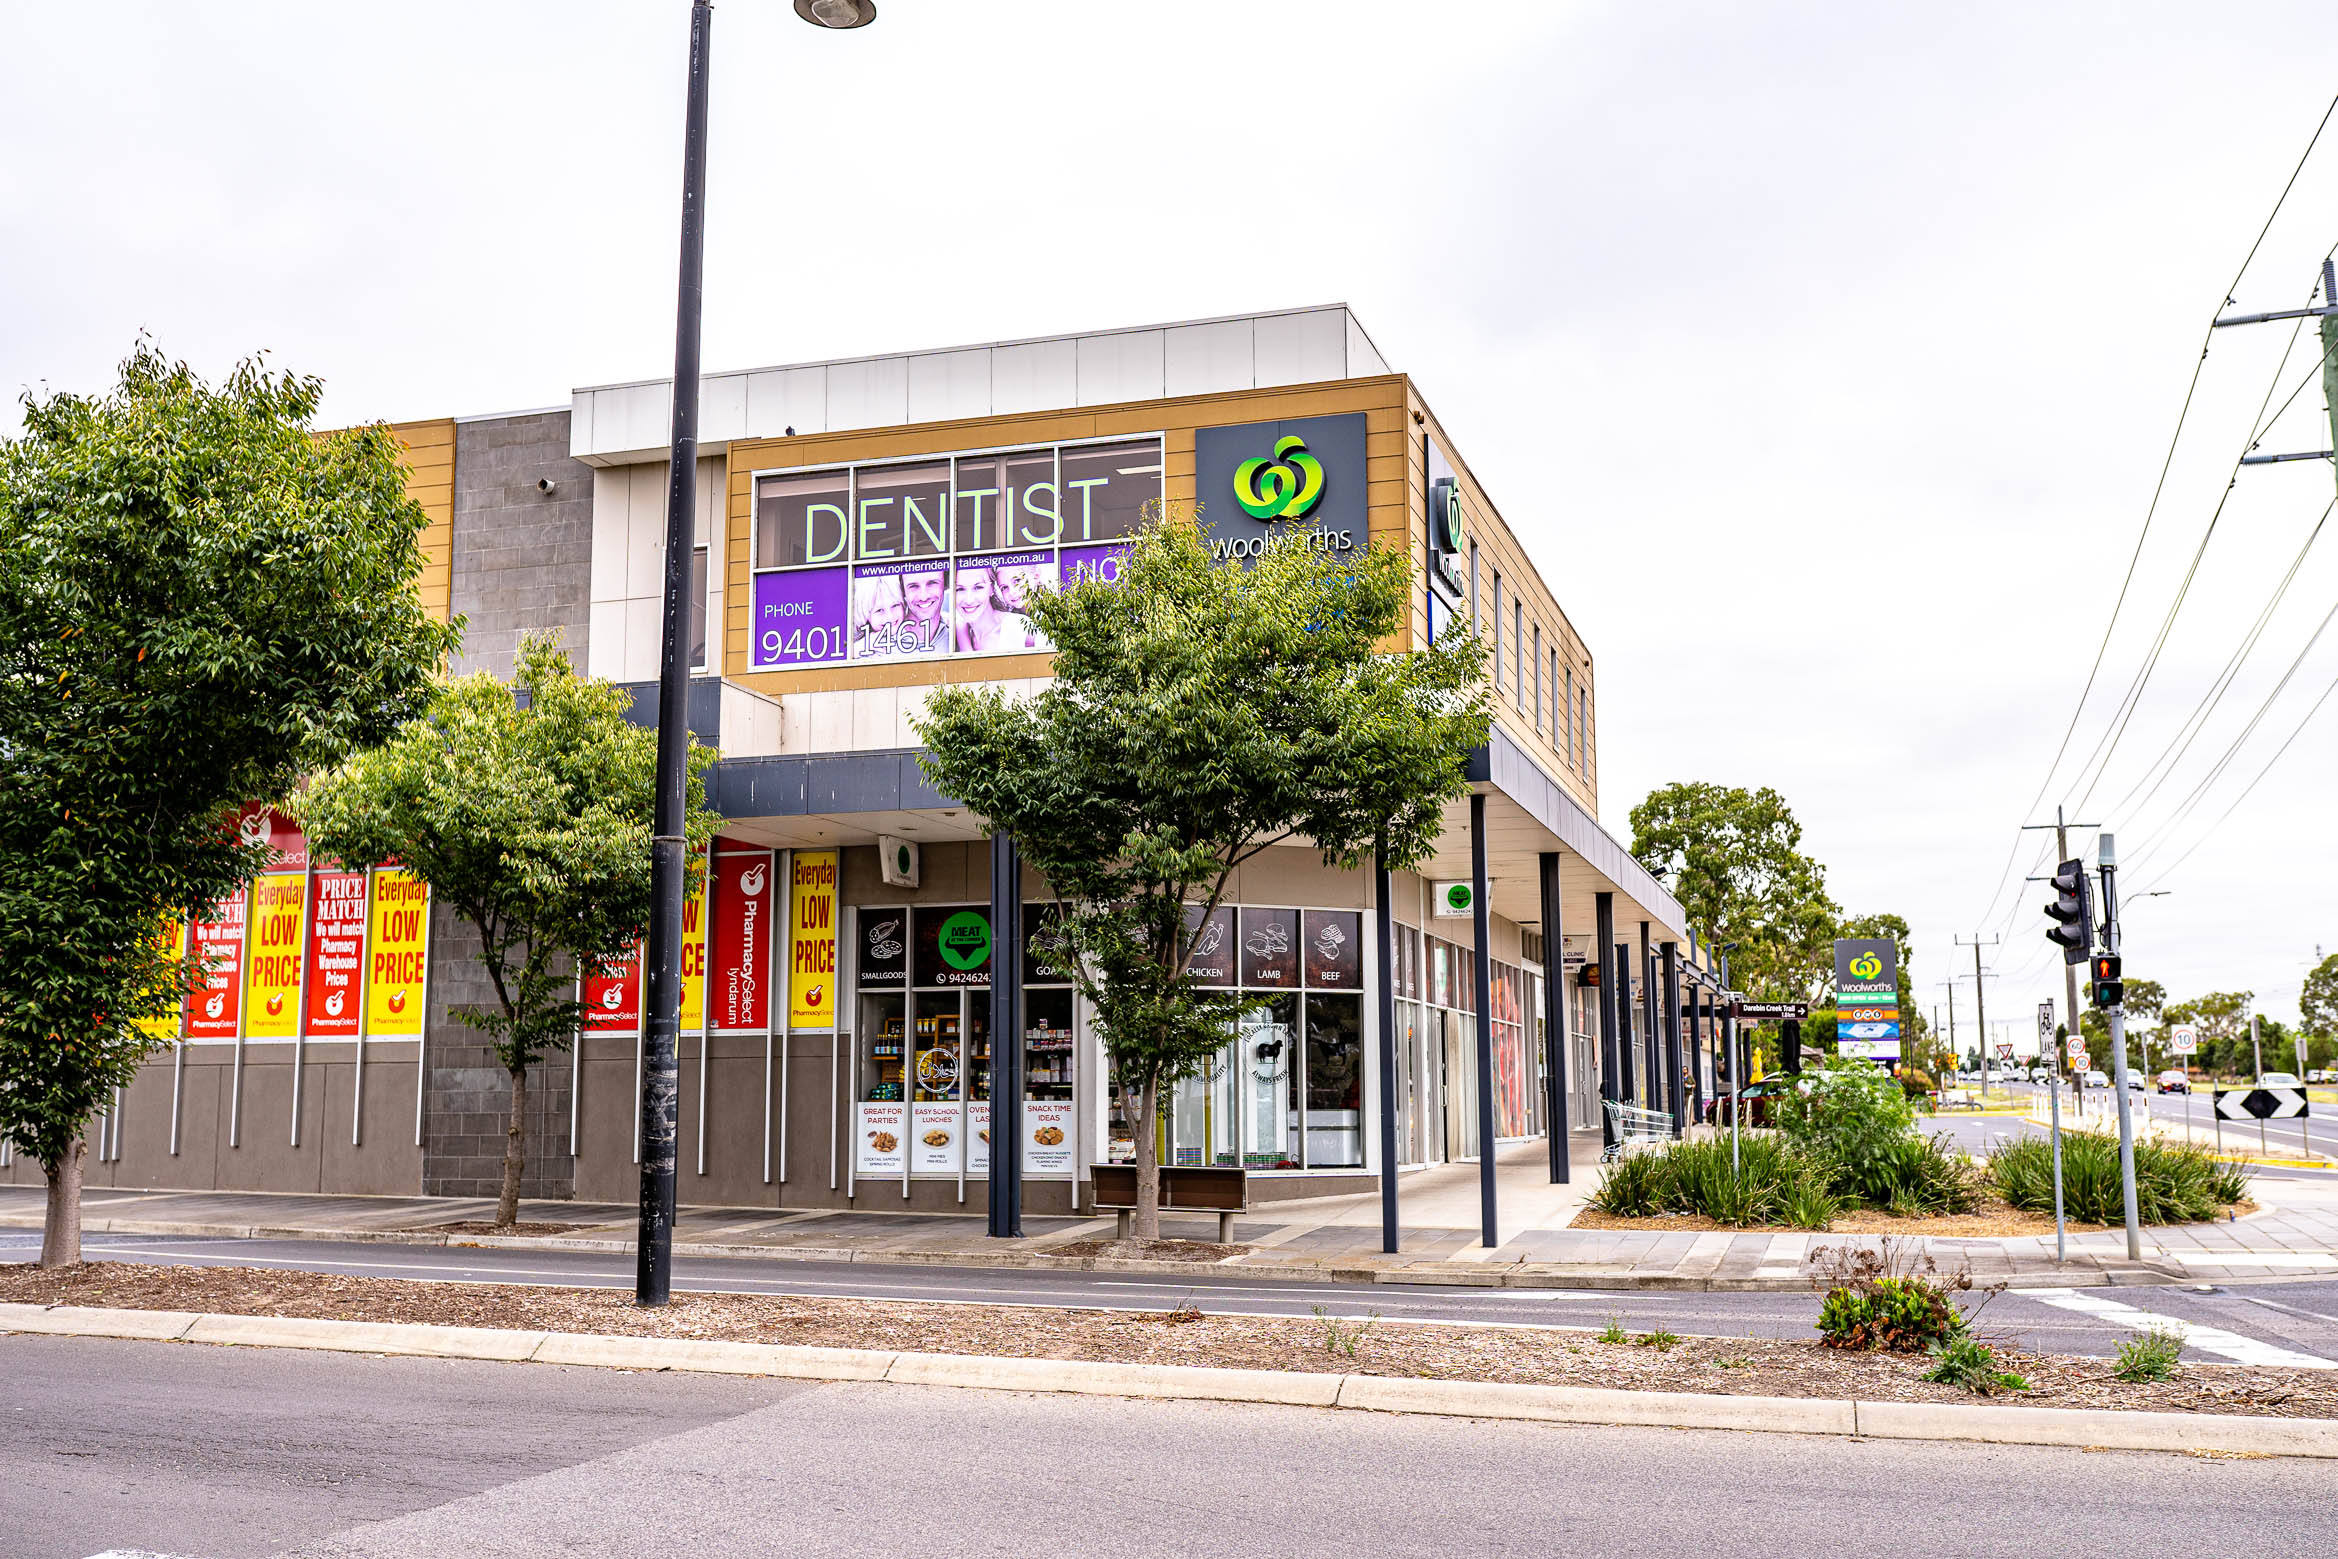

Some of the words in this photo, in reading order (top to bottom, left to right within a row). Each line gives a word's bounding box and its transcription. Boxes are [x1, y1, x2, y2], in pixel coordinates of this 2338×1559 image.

[806, 477, 1109, 563] DENTIST
[1076, 554, 1129, 585] NO
[764, 601, 814, 618] PHONE
[762, 625, 845, 663] 9401
[859, 618, 935, 656] 1461
[795, 859, 836, 890] Everyday
[257, 878, 305, 910] Everyday
[321, 878, 363, 899] PRICE
[378, 876, 428, 906] Everyday
[317, 899, 364, 921] MATCH
[801, 895, 831, 929] LOW
[197, 925, 208, 941] We
[208, 925, 221, 941] will
[222, 923, 243, 939] match
[261, 914, 298, 947] LOW
[315, 922, 327, 937] We
[327, 921, 341, 937] will
[341, 920, 365, 936] match
[382, 910, 420, 943] LOW
[951, 926, 982, 937] MEAT
[321, 938, 357, 955] Pharmacy
[318, 955, 358, 970] Warehouse
[740, 900, 758, 1024] PharmacySelect
[796, 939, 835, 973] PRICE
[253, 955, 301, 988] PRICE
[374, 951, 425, 985] PRICE
[861, 971, 907, 980] SMALLGOODS
[1036, 966, 1057, 975] GOA
[1186, 968, 1223, 977] CHICKEN
[1257, 970, 1281, 979] LAMB
[1321, 971, 1341, 981] BEEF
[325, 971, 348, 987] Prices
[727, 968, 739, 1025] lyndarum
[1743, 1004, 1765, 1012] Darebin
[1766, 1004, 1782, 1012] Creek
[193, 1019, 236, 1029] PharmacySelect
[312, 1018, 357, 1027] PharmacySelect
[2071, 1042, 2082, 1050] 60
[2178, 1034, 2191, 1045] 10
[2078, 1058, 2087, 1067] 10
[1251, 1069, 1272, 1084] ALWAYS
[1038, 1114, 1061, 1122] IDEAS
